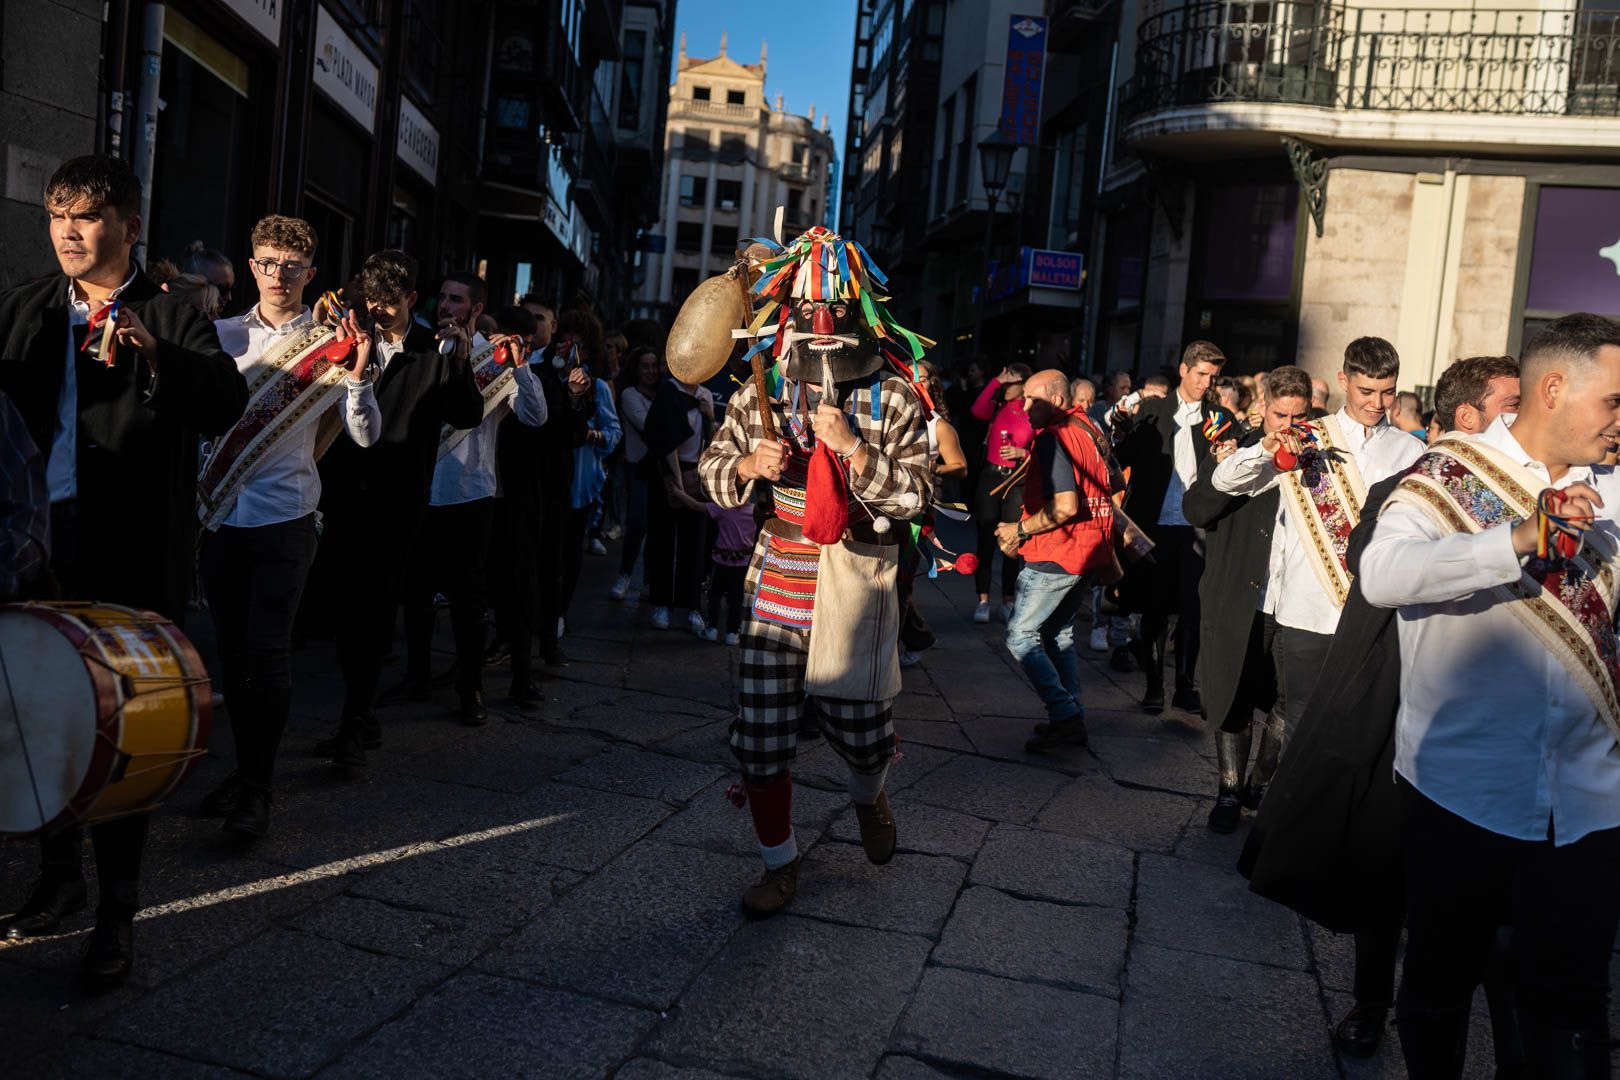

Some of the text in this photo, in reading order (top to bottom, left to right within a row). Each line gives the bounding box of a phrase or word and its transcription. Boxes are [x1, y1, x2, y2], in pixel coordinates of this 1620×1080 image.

[332, 46, 375, 112] PLAZA MAYOR
[1036, 254, 1077, 270] BOLSOS
[1032, 271, 1077, 285] MALETAS
